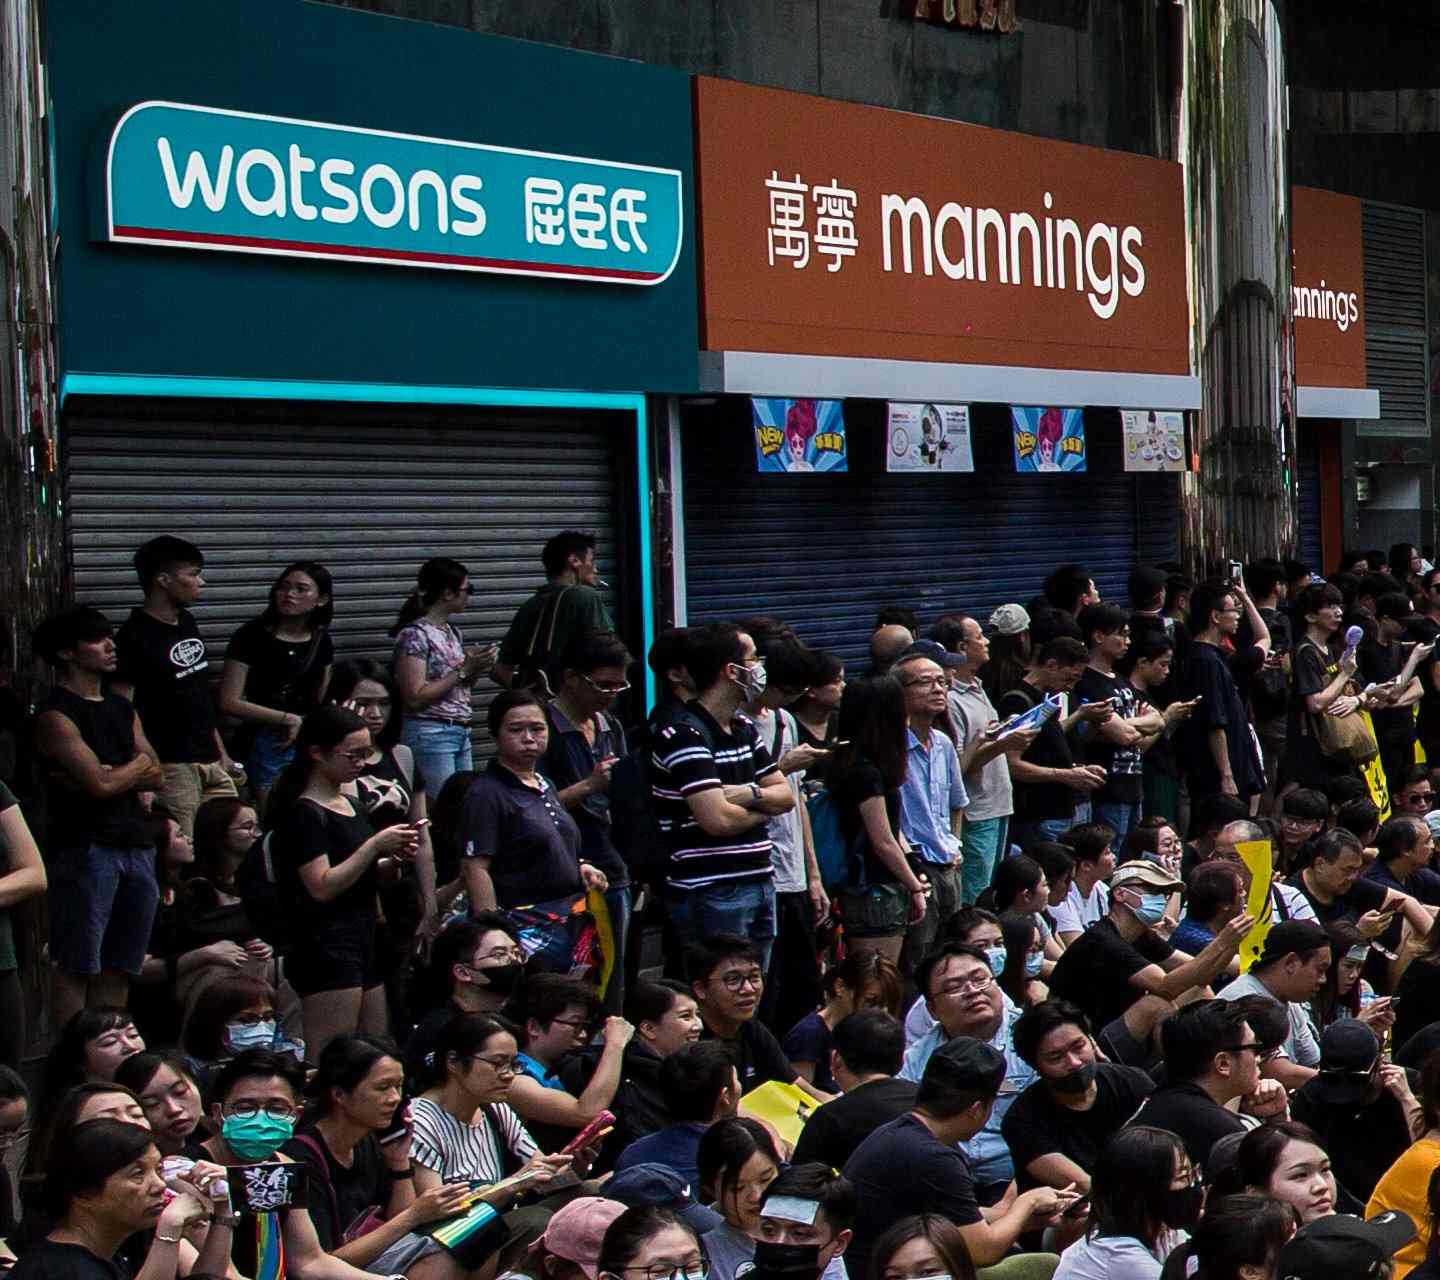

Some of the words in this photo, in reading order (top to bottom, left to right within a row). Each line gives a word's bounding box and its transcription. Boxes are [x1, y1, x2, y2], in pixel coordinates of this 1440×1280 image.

[157, 135, 486, 238] watsons
[524, 177, 649, 254] 屈臣氏
[764, 171, 859, 273] 萬寧
[881, 192, 1146, 318] mannings
[1293, 280, 1358, 331] annings
